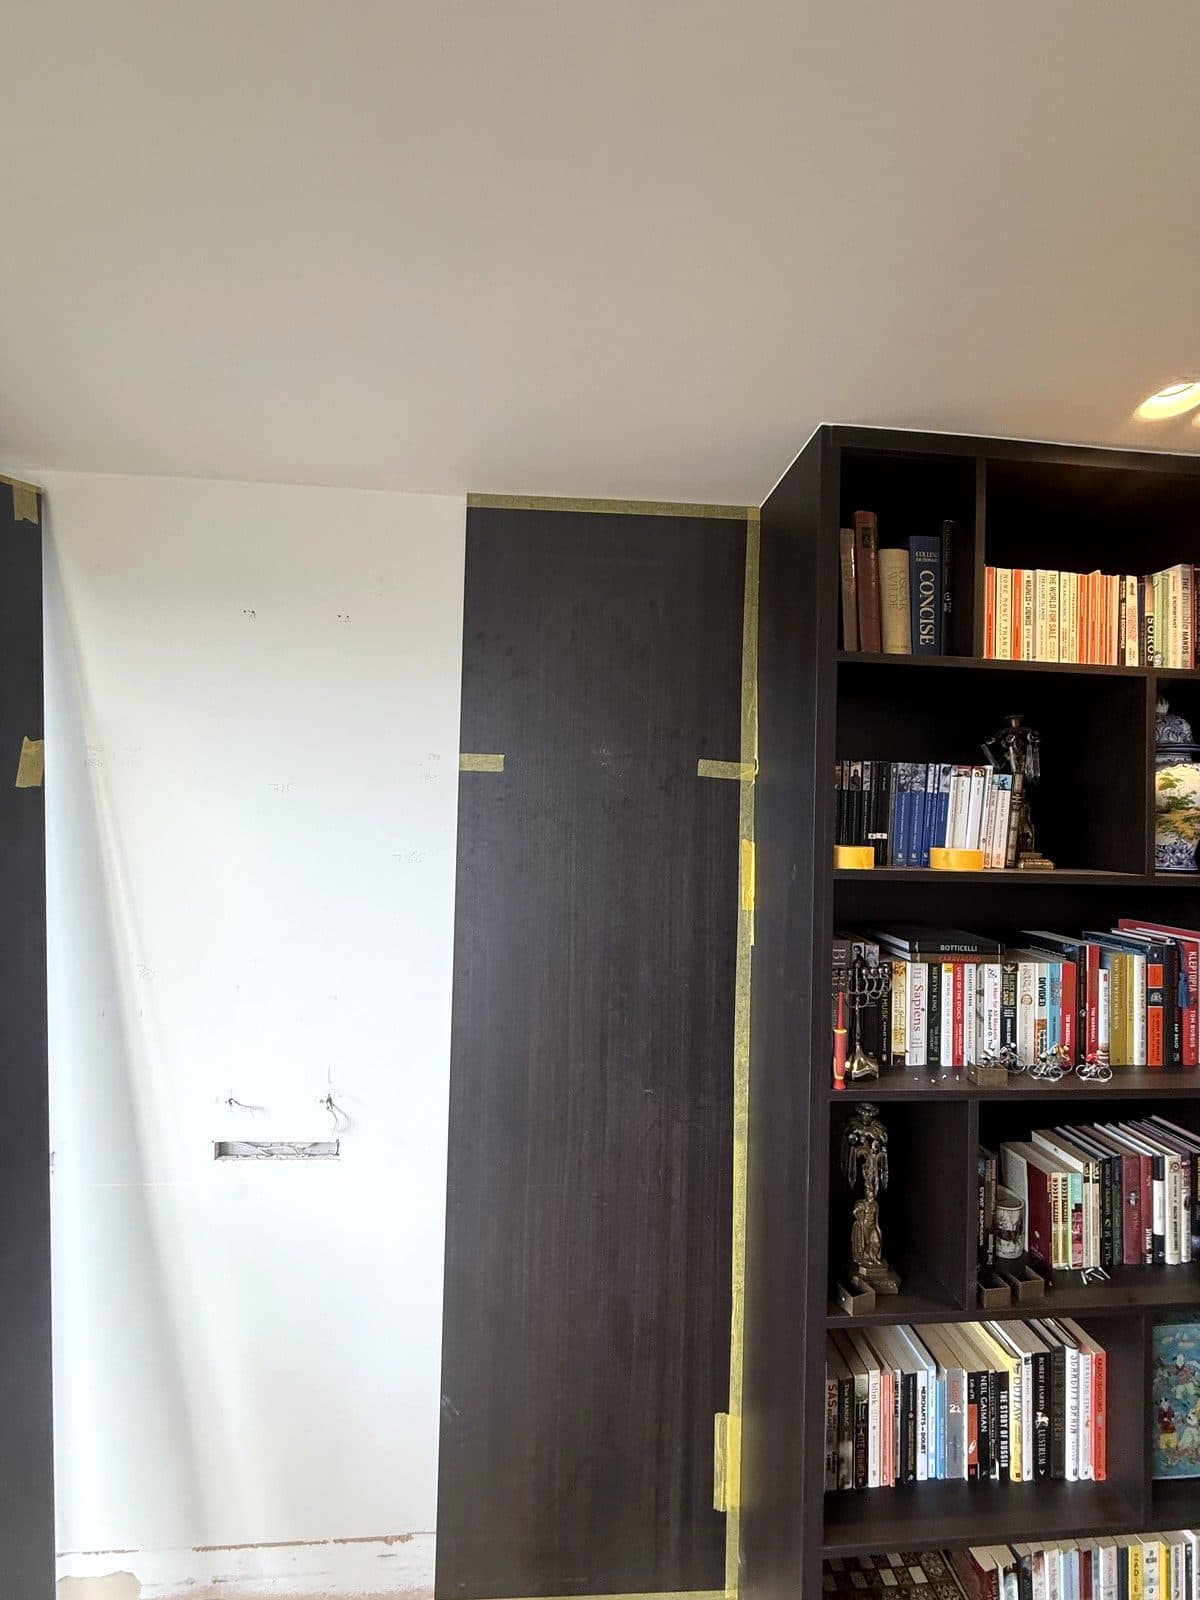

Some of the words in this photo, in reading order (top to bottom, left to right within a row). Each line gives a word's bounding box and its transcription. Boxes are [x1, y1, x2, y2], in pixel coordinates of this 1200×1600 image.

[920, 570, 935, 646] CONCISE
[1147, 617, 1155, 661] SOROS
[1188, 951, 1197, 992] KLEPTOPIA
[912, 984, 924, 1032] Sapiens
[1038, 977, 1046, 1007] DIVIDED
[828, 1383, 837, 1408] SAS
[980, 1375, 988, 1395] NEIL
[1000, 1390, 1008, 1403] THE
[1013, 1377, 1022, 1424] OUTLAW
[980, 1396, 988, 1433] GAIMAN
[1000, 1404, 1008, 1428] STORY
[1000, 1429, 1008, 1439] OF
[1038, 1429, 1046, 1465] LUSTRUM
[1000, 1440, 1008, 1468] RUSSIA
